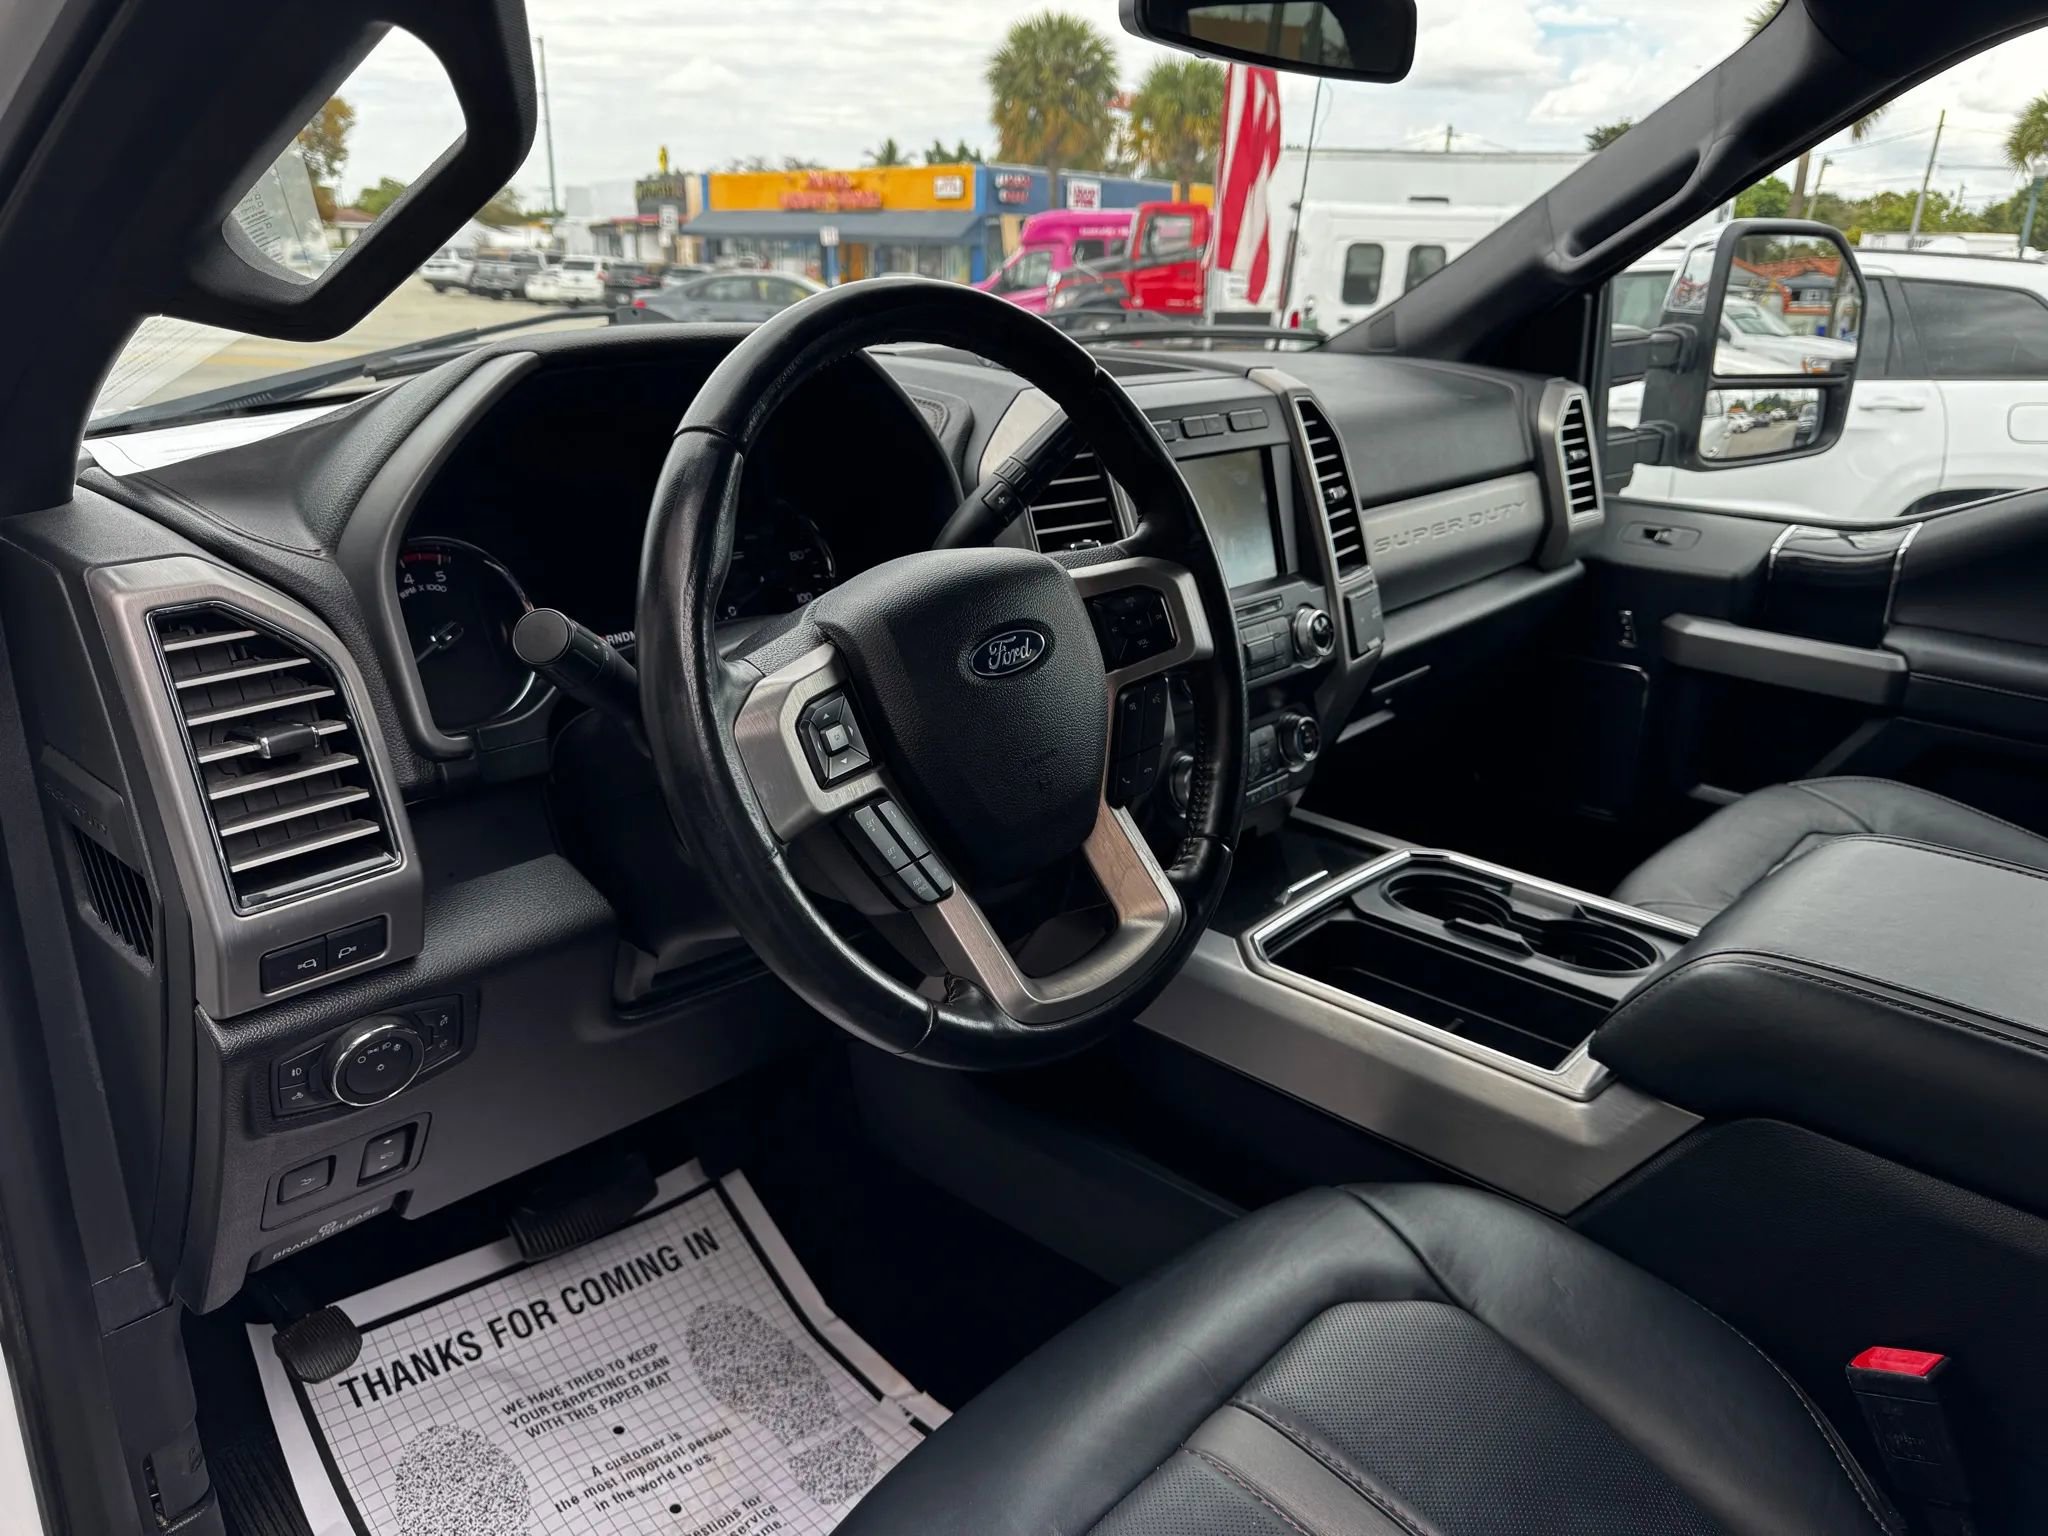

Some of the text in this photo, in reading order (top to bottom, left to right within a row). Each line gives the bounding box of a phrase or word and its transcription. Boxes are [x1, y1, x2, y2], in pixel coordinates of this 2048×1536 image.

[1374, 500, 1528, 554] SUPER DUTY
[403, 570, 447, 585] 4 5
[989, 636, 1032, 669] Ford
[272, 1206, 379, 1260] BRAKE RELEASE
[338, 1227, 720, 1408] THANKS FOR COMING IN
[501, 1343, 658, 1416] WE HAVE TRIED TO KEEP
[509, 1355, 671, 1429] YOUR CARPETING CLEAN
[525, 1371, 672, 1439] WITH THIS PAPER MAT
[555, 1427, 732, 1513] the most important person
[591, 1431, 682, 1477] A customer is
[594, 1453, 717, 1512] in the world to us.
[741, 1495, 762, 1510] for
